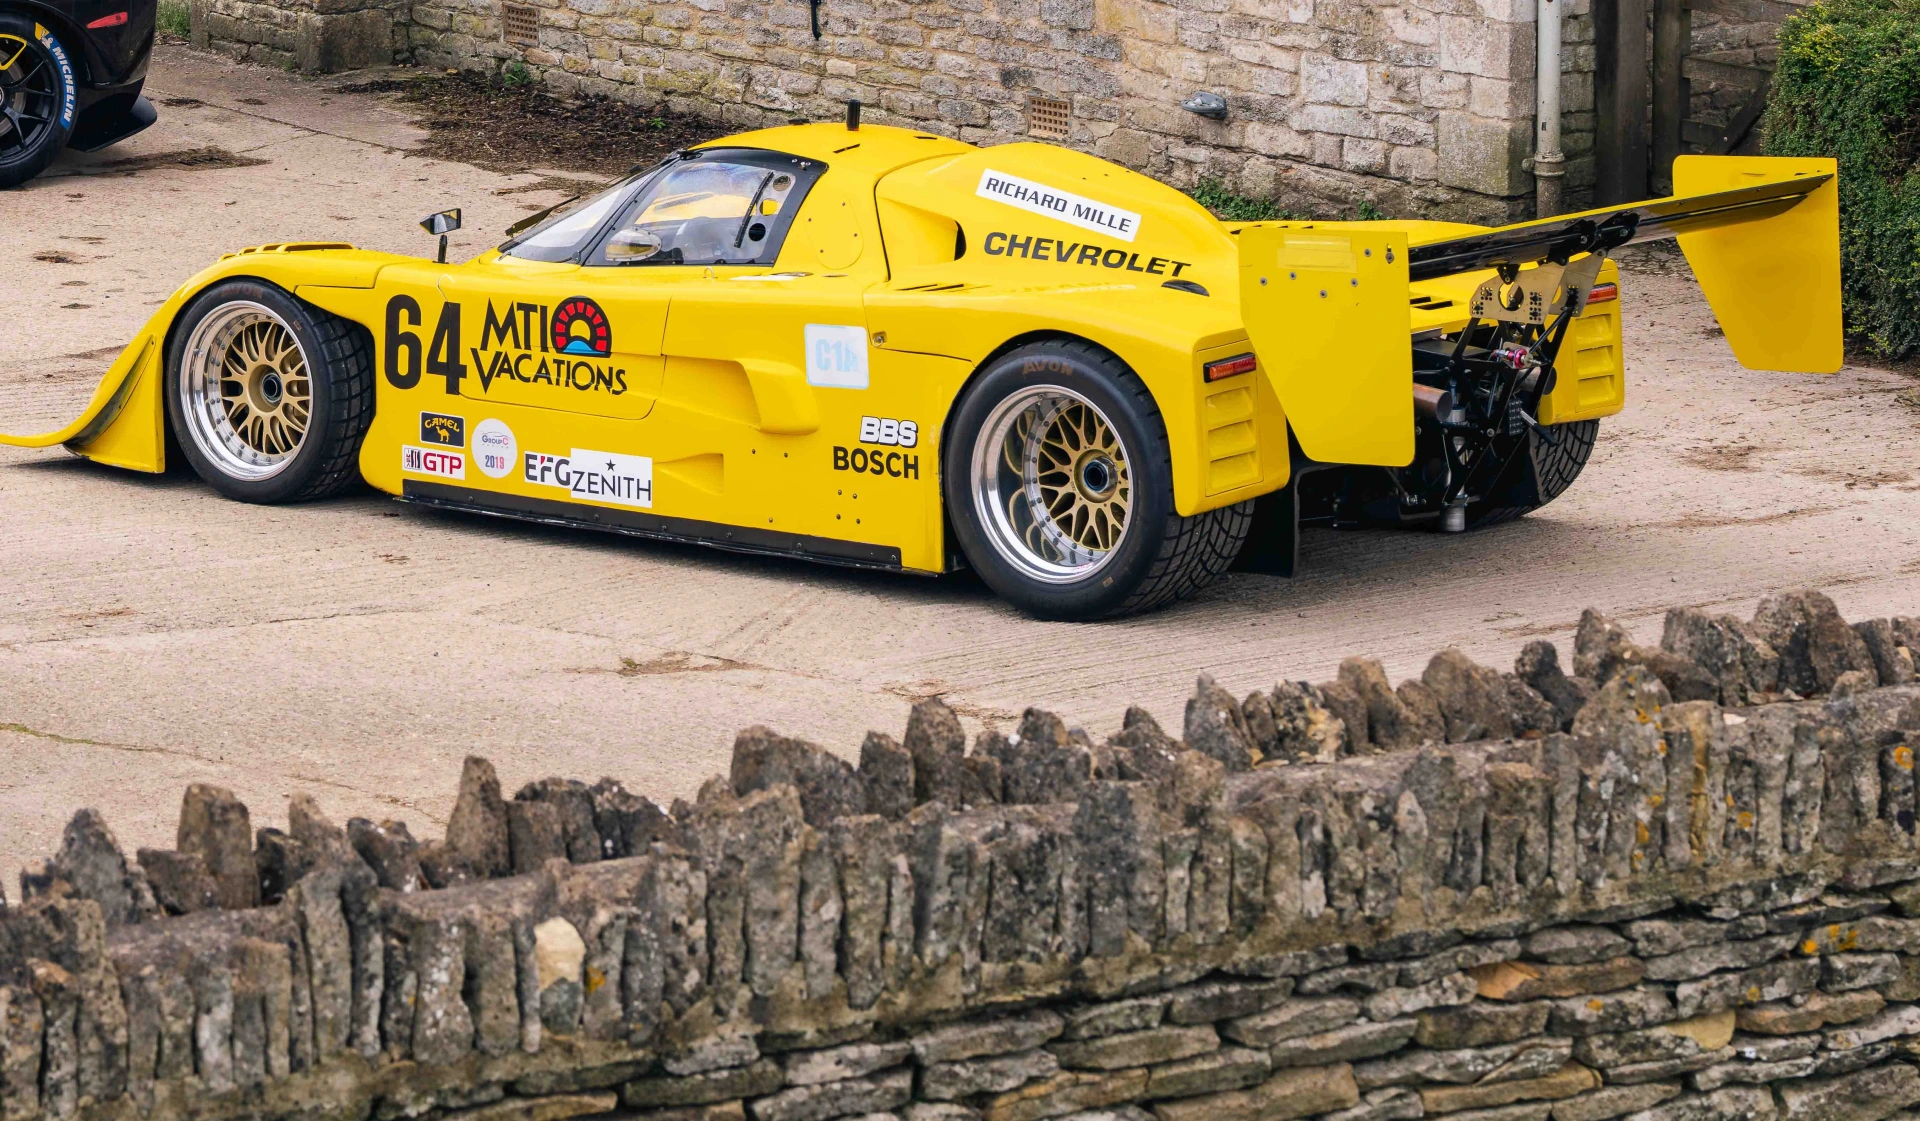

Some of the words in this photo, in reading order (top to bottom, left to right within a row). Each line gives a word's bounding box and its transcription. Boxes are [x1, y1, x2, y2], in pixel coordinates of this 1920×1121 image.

[52, 46, 76, 122] MICHELIN
[985, 177, 1068, 213] RICHARD
[1072, 203, 1132, 234] MILLE
[984, 232, 1192, 278] CHEVROLET
[480, 297, 549, 353] MTI
[384, 294, 467, 395] 64
[470, 347, 628, 395] VACATIONS
[1023, 359, 1074, 376] AVON
[424, 417, 460, 433] CAMEL
[860, 416, 918, 448] BBS
[423, 452, 462, 474] GTP
[485, 454, 504, 470] 2019
[525, 453, 571, 486] EFG
[833, 445, 919, 480] BOSCH
[571, 469, 652, 502] ZENITH
